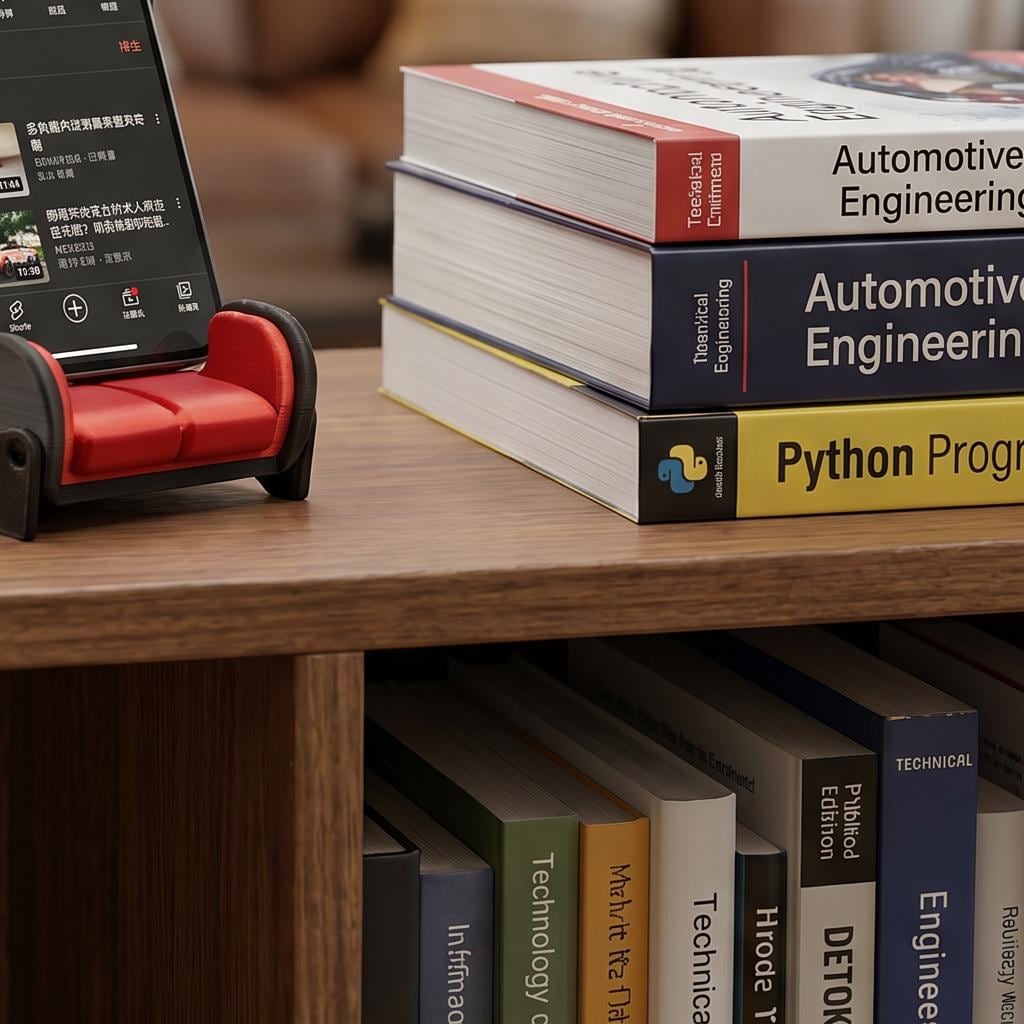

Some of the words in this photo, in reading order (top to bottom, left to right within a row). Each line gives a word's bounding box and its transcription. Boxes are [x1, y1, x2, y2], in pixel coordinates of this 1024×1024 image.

[832, 139, 1024, 175] Automotive
[804, 264, 1024, 313] Automotiv
[777, 437, 913, 492] Python
[895, 753, 973, 772] TECHNICAL
[525, 852, 555, 1003] Technology
[912, 890, 948, 1024] Enginee
